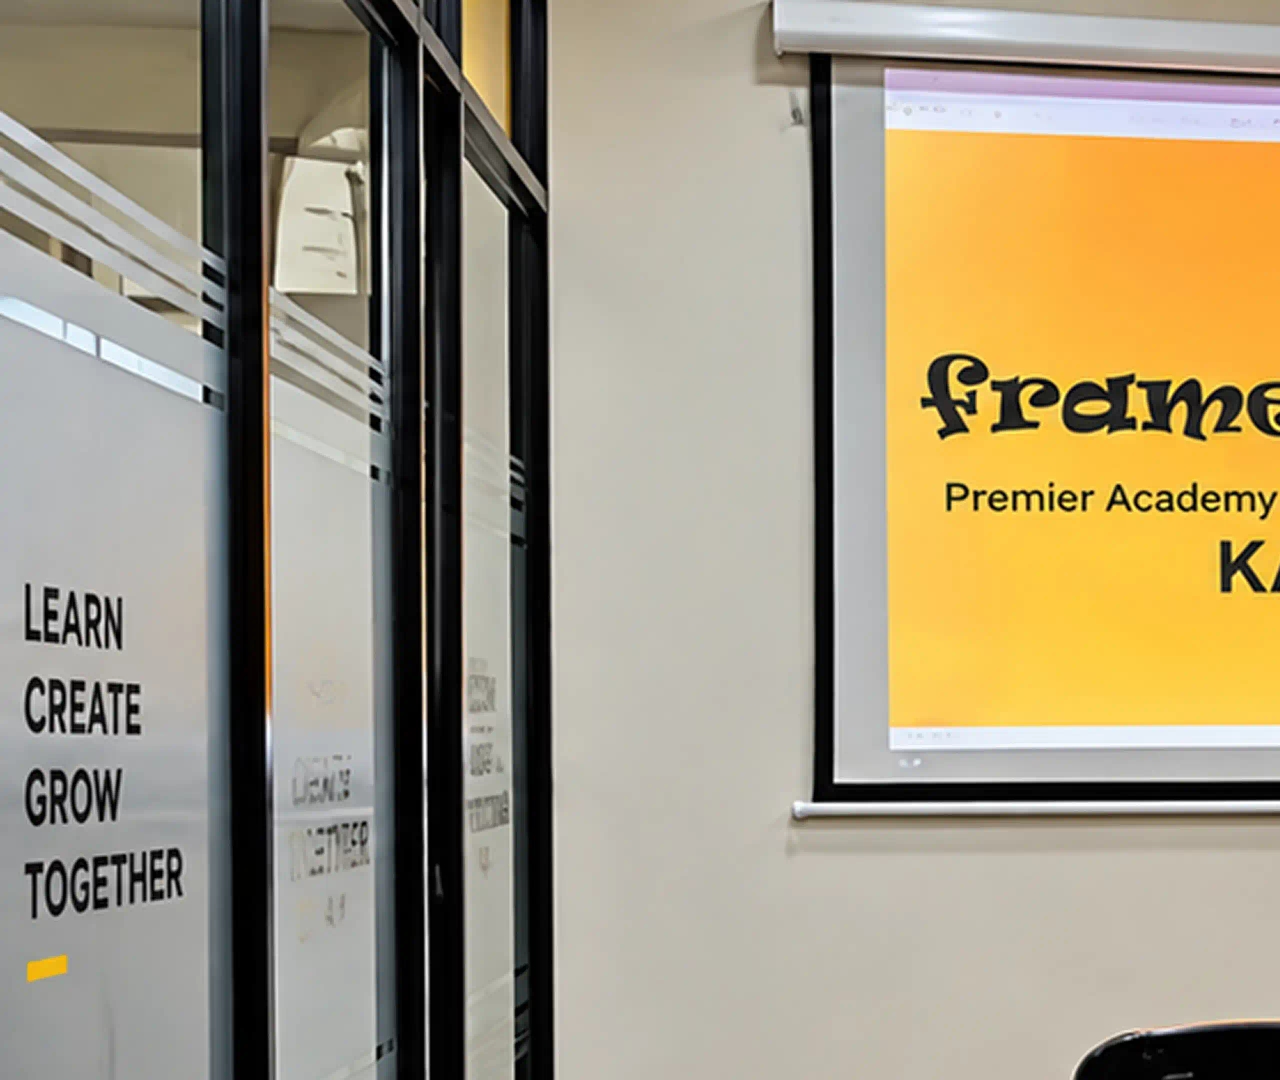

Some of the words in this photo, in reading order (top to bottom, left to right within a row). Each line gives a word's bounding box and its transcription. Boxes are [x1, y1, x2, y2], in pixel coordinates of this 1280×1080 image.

[946, 481, 1095, 513] Premier
[1105, 482, 1278, 521] Academy
[24, 582, 123, 651] LEARN
[24, 676, 142, 736] CREATE
[24, 767, 123, 828] GROW
[23, 847, 184, 920] TOGETHER
